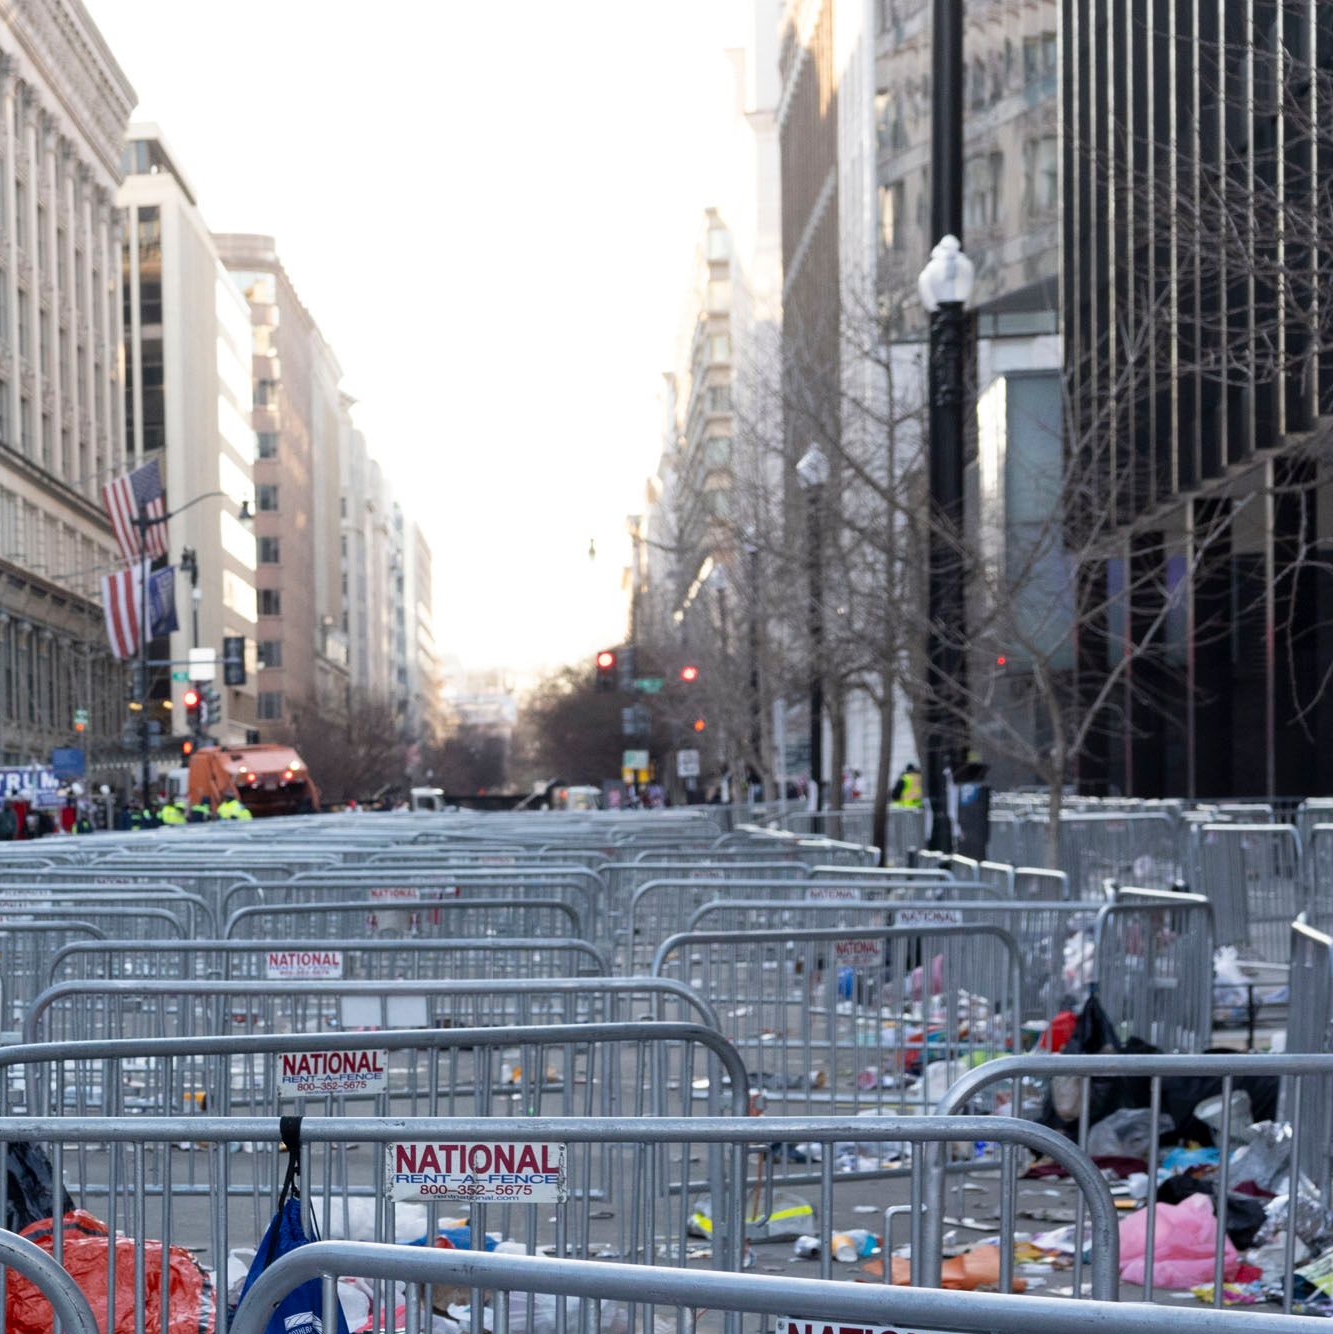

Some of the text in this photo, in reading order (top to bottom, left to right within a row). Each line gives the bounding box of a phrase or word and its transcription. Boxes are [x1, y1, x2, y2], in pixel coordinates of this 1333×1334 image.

[268, 952, 340, 967] NATIONAL
[282, 1051, 384, 1076] NATIONAL
[296, 1080, 368, 1092] 800-352-5675
[395, 1144, 560, 1175] NATIONAL
[395, 1174, 559, 1185] RENT-A-FENCE
[419, 1184, 533, 1196] 800-352-5675
